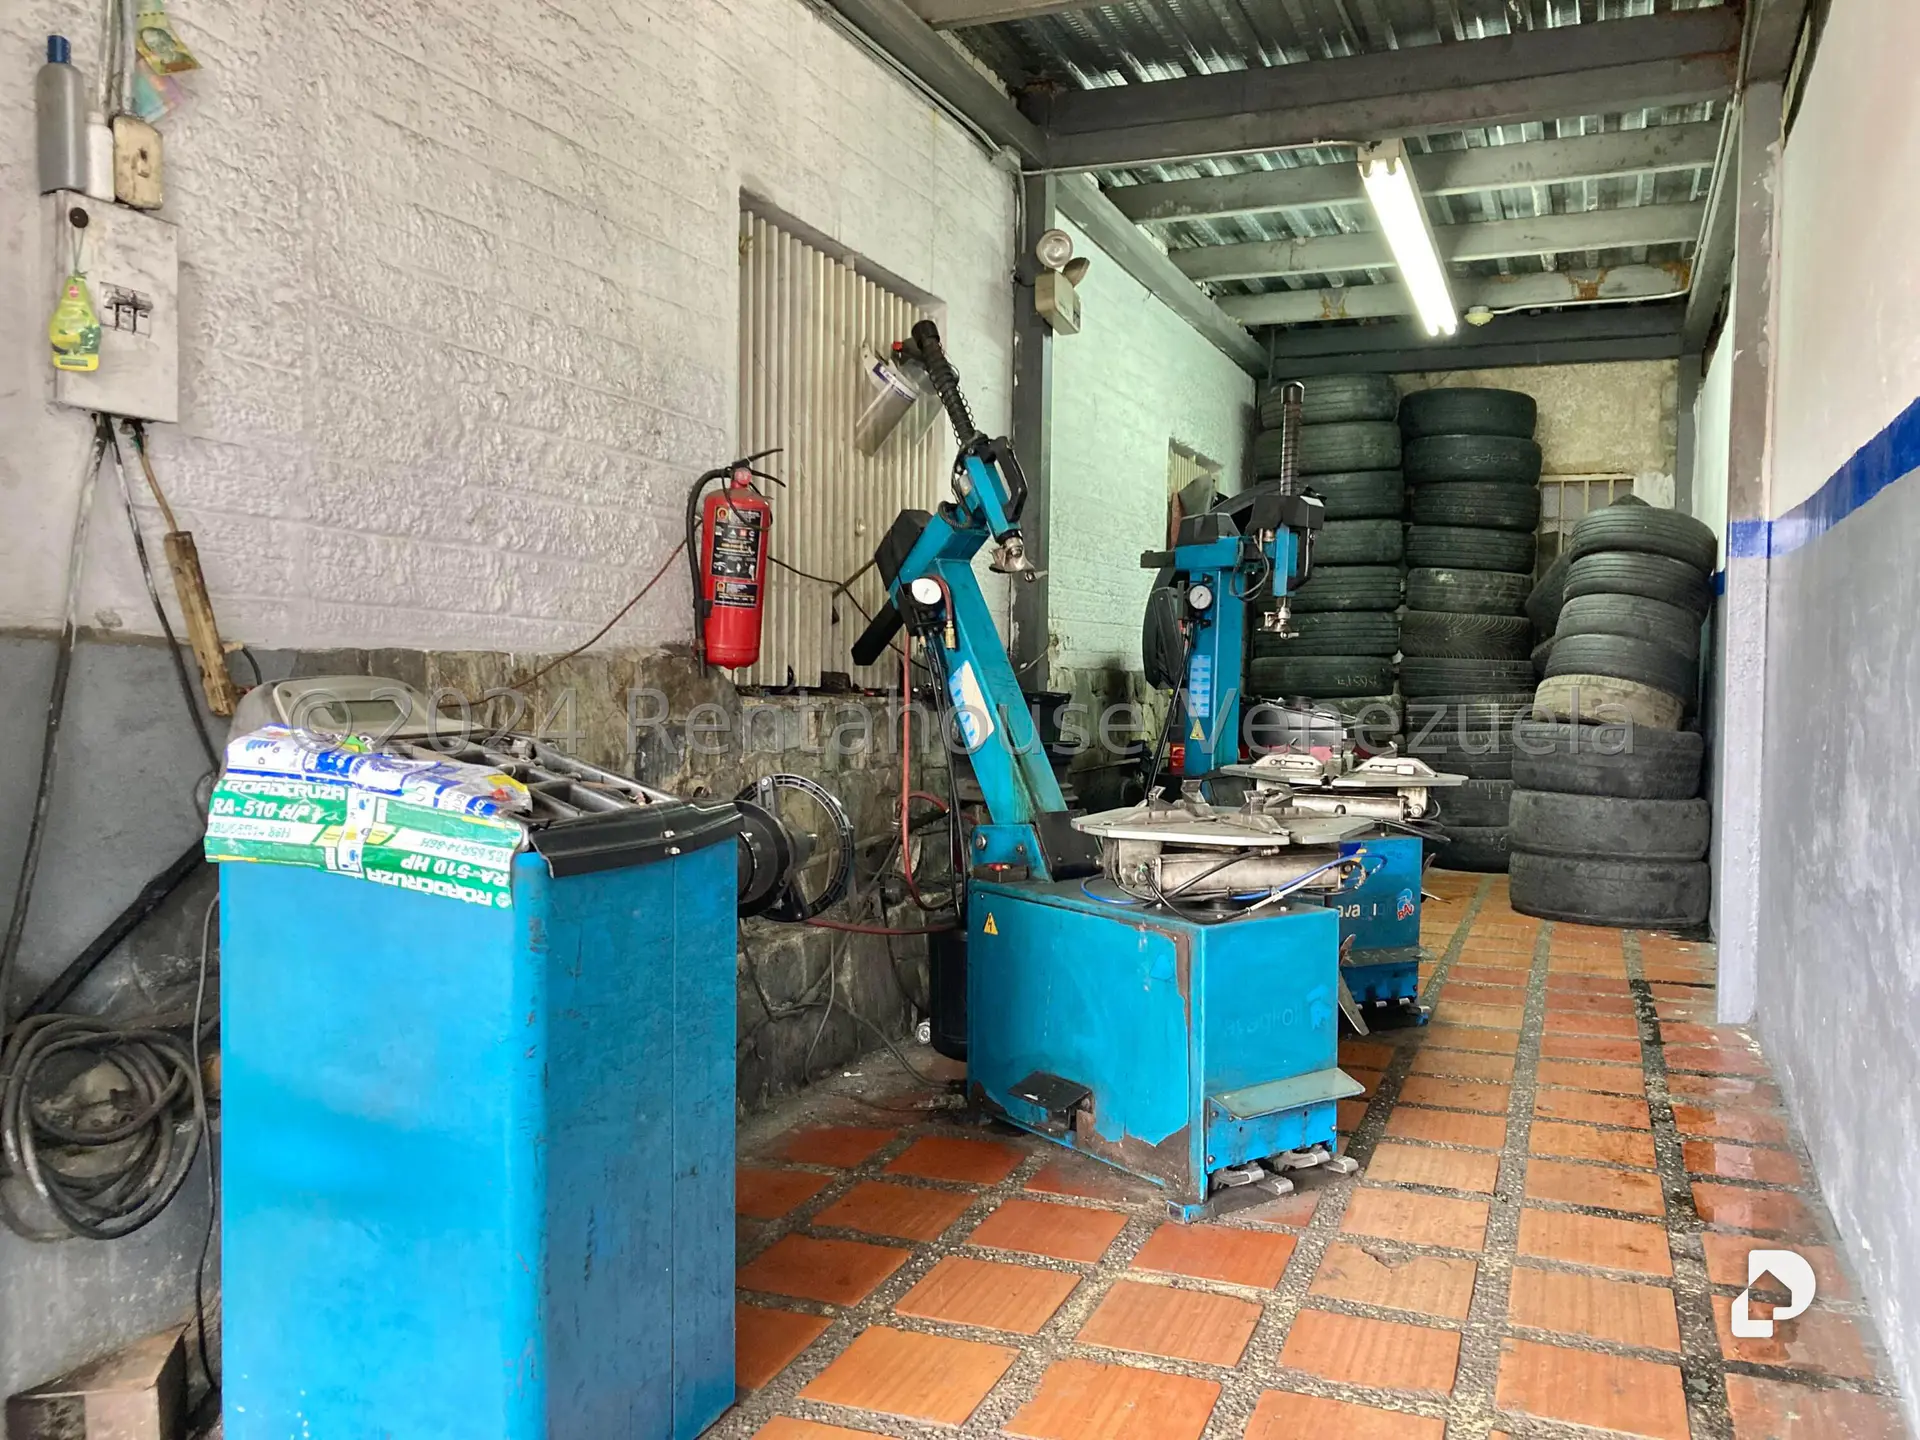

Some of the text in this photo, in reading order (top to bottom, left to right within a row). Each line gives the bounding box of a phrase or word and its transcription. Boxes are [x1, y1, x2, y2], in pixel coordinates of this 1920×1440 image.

[213, 798, 277, 818] RA-510
[365, 867, 493, 907] ROADCRUZA
[400, 853, 509, 887] RA-510 HP
